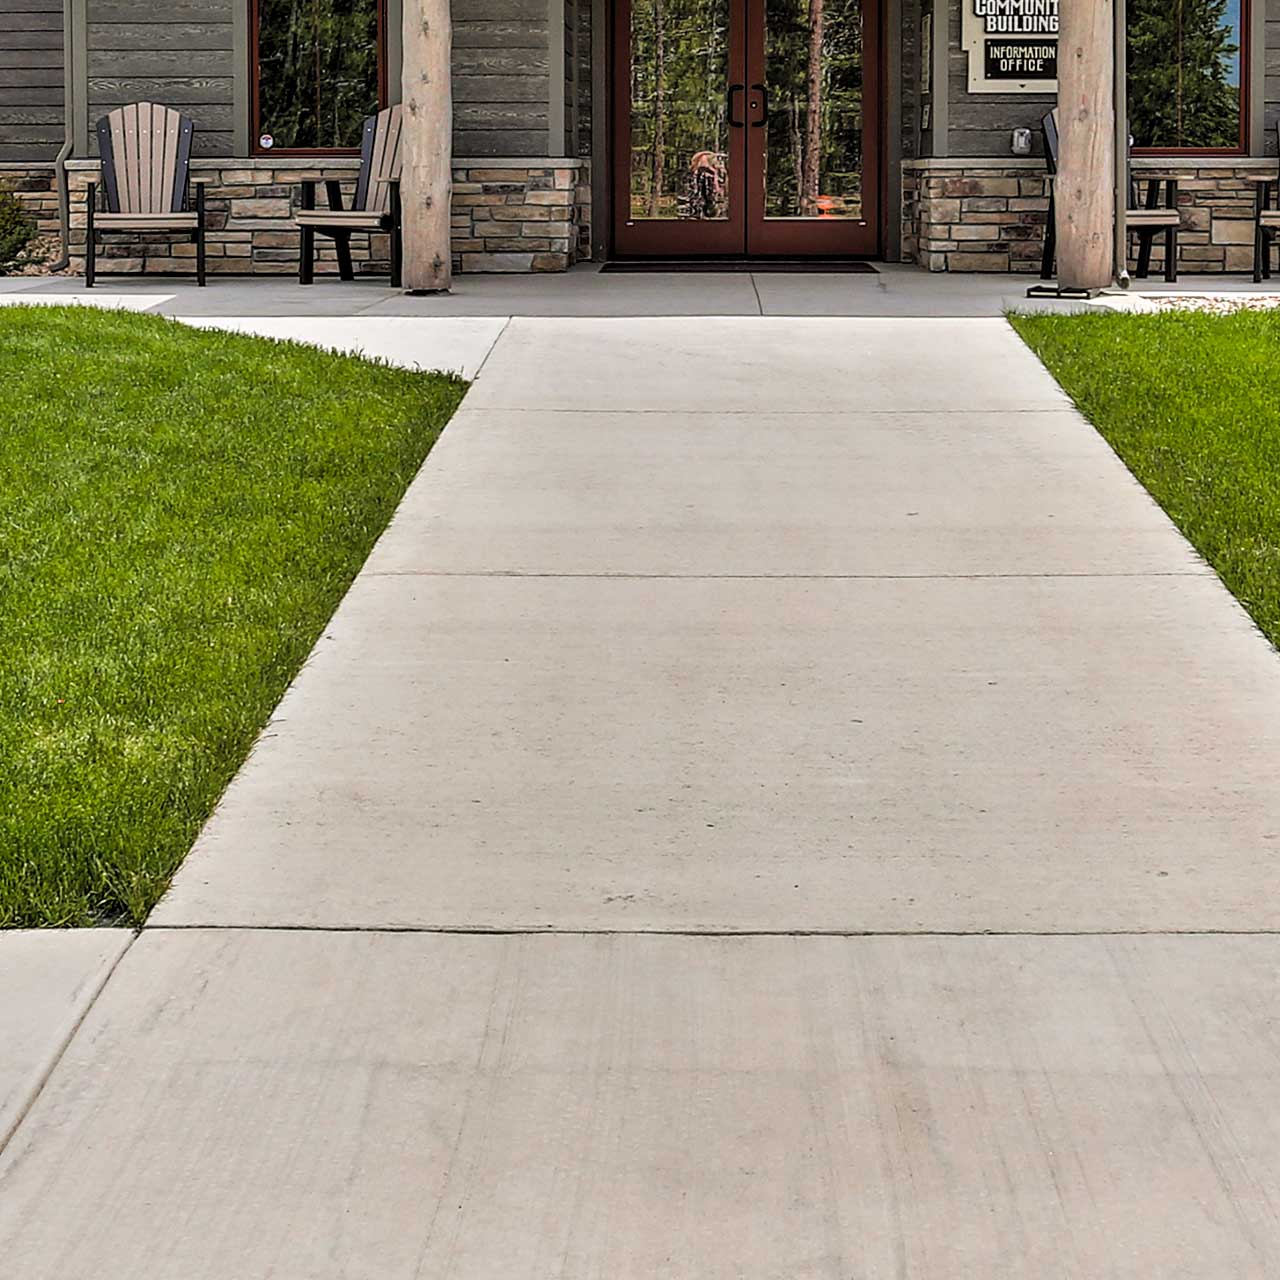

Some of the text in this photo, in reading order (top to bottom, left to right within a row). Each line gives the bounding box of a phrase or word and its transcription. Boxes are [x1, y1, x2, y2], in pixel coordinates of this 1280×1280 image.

[986, 15, 1059, 32] BUILDING
[990, 46, 1056, 59] INFORMATION
[1000, 59, 1044, 72] OFFICE
